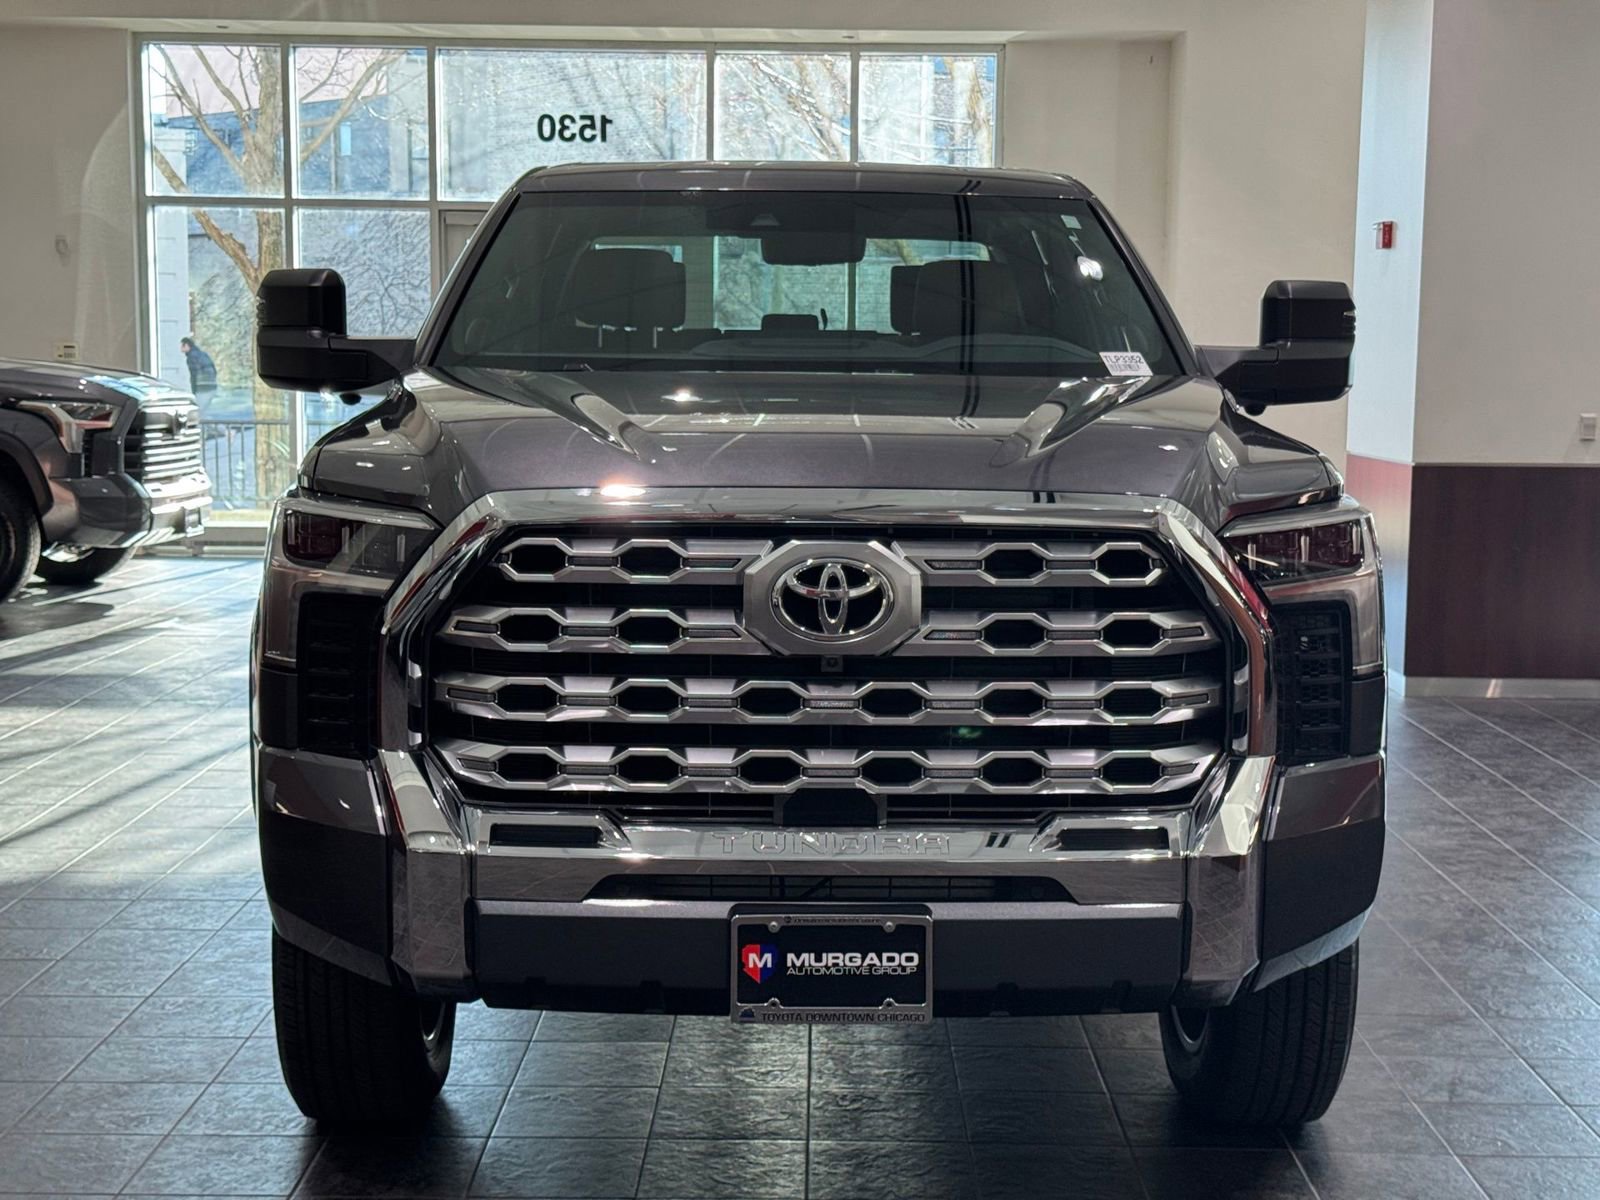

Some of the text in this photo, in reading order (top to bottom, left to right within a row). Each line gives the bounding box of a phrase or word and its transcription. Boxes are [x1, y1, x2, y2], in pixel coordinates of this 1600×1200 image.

[711, 831, 950, 855] TUNDRA
[748, 952, 773, 968] M
[786, 952, 919, 968] MURGADO
[786, 966, 917, 976] AUTOMOTIVE GROUP
[762, 1012, 926, 1022] TOYOTA DOWNTOWN CHICAGO
